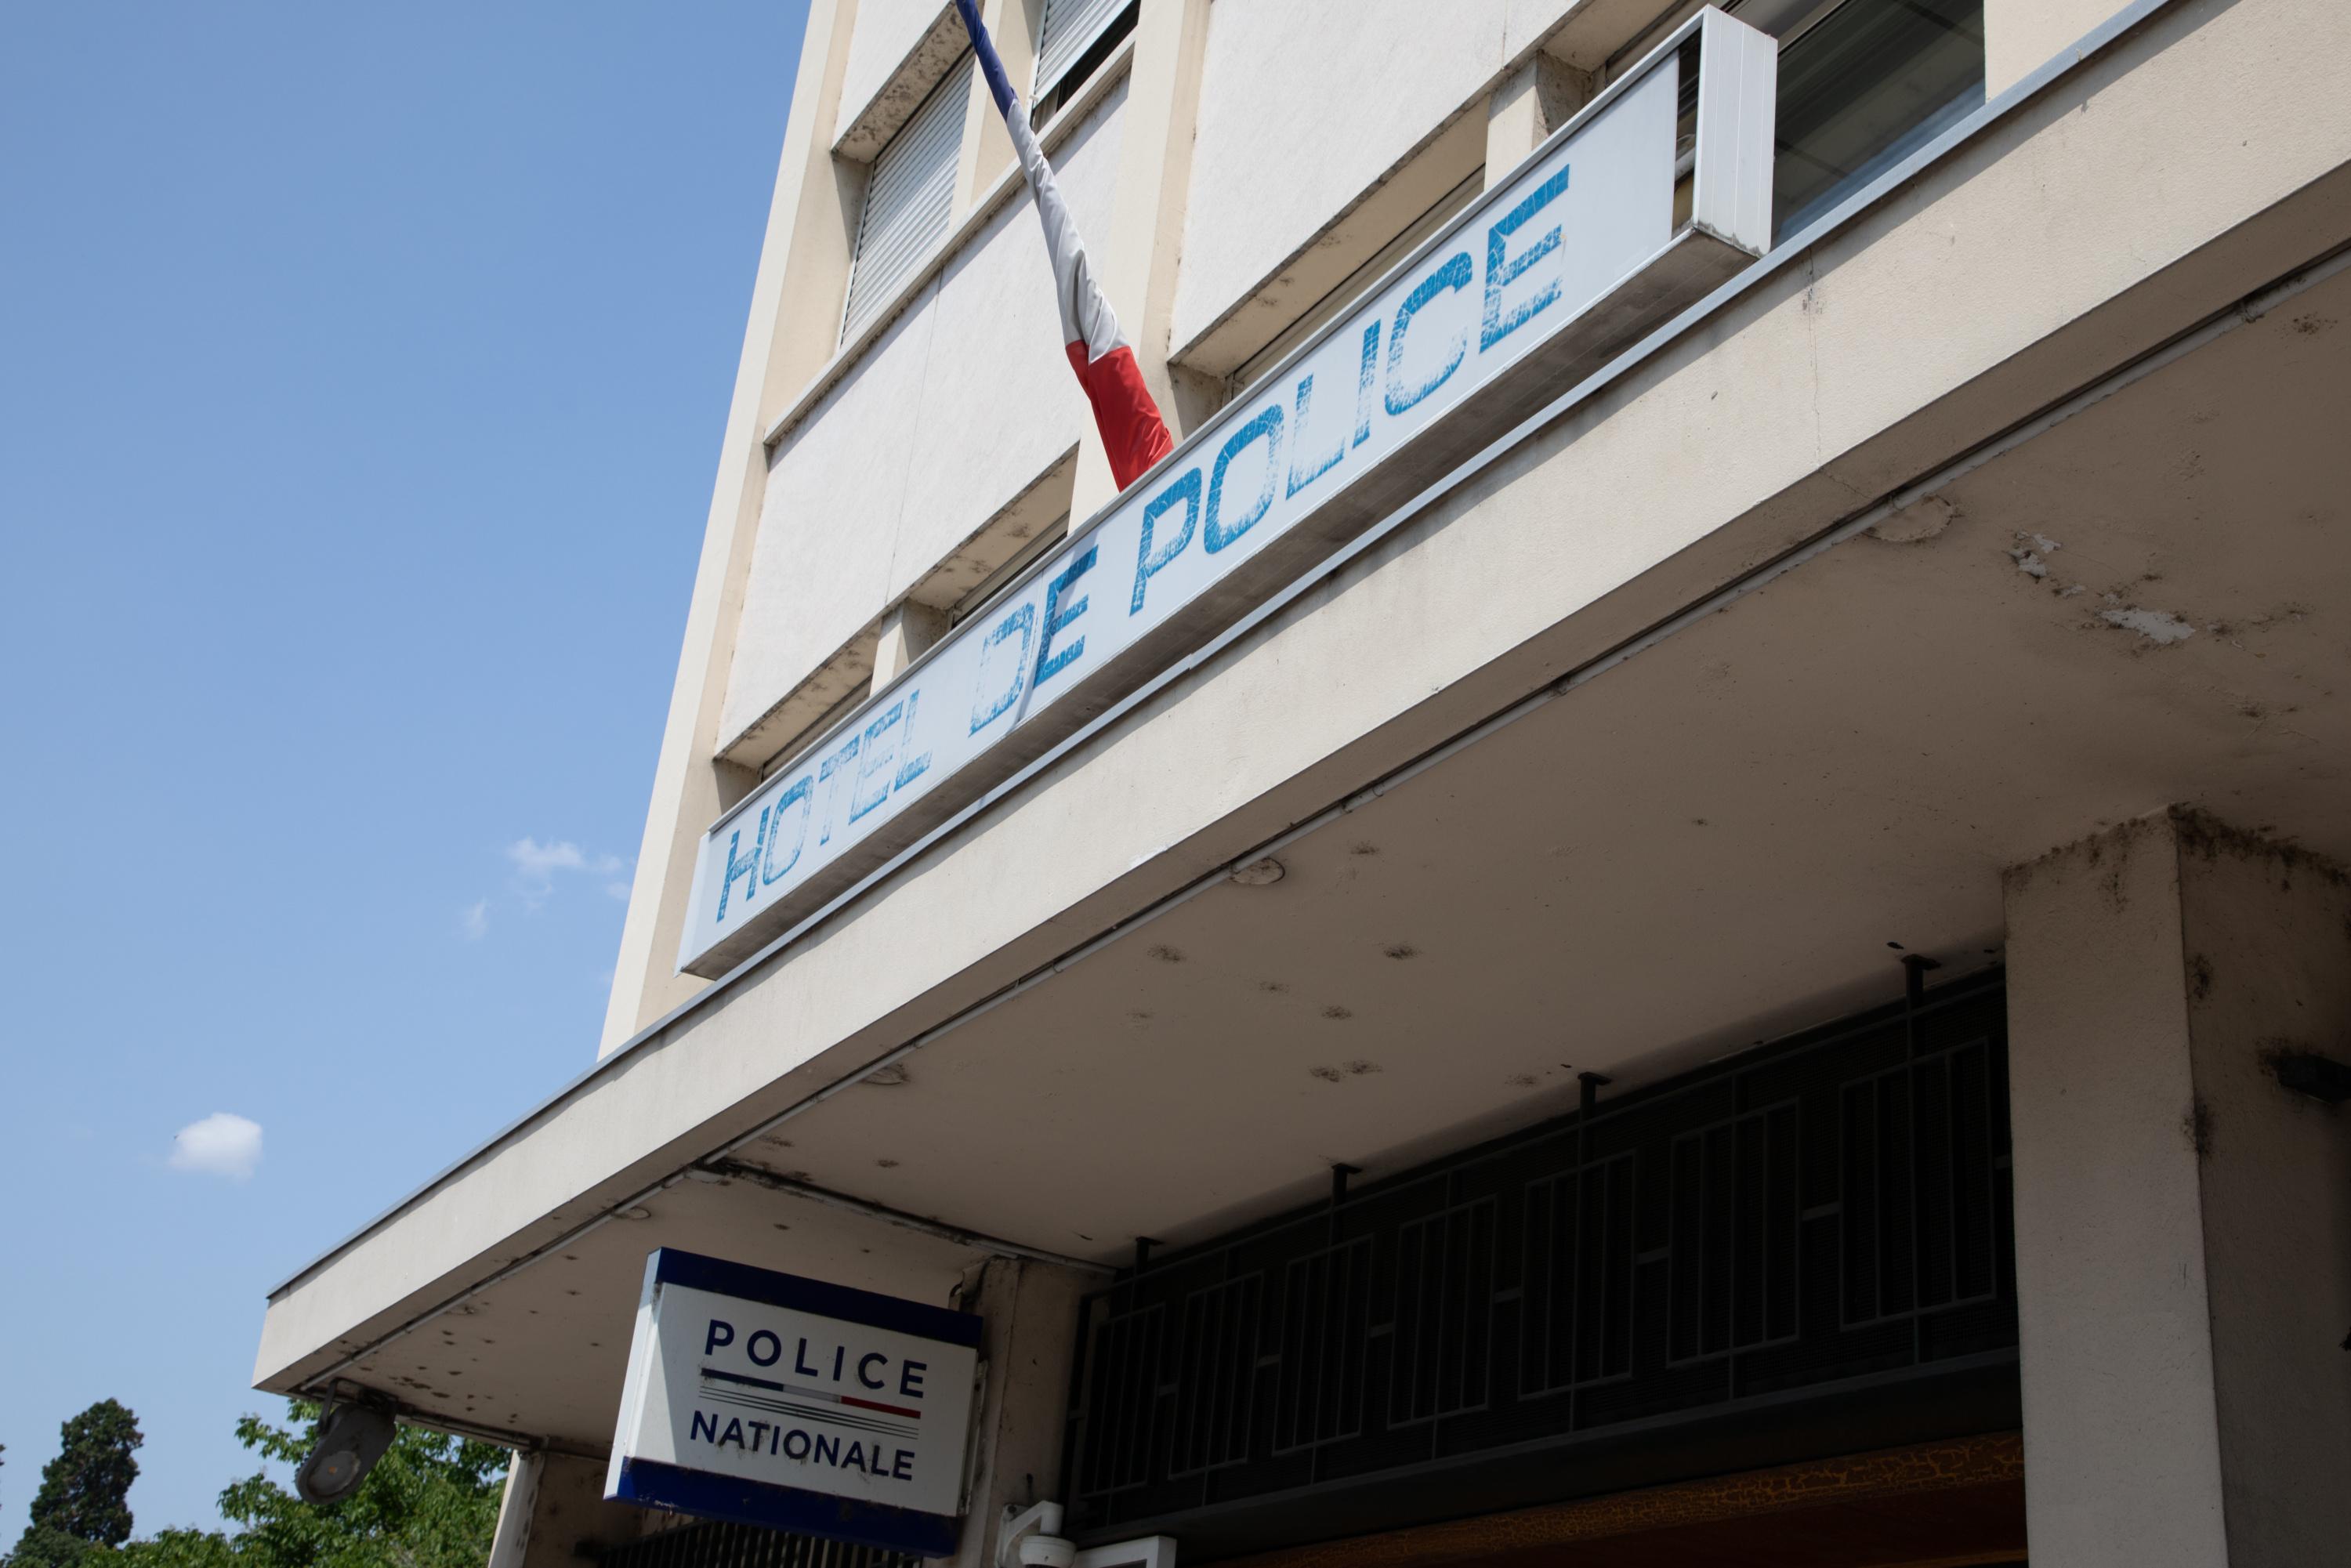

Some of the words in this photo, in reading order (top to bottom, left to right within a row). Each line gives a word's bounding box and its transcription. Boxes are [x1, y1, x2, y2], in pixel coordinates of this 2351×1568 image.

[716, 689, 933, 923] HOTEL
[968, 544, 1099, 738] DE
[1129, 163, 1570, 617] POLICE
[705, 1319, 928, 1399] POLICE
[690, 1410, 915, 1481] NATIONALE
